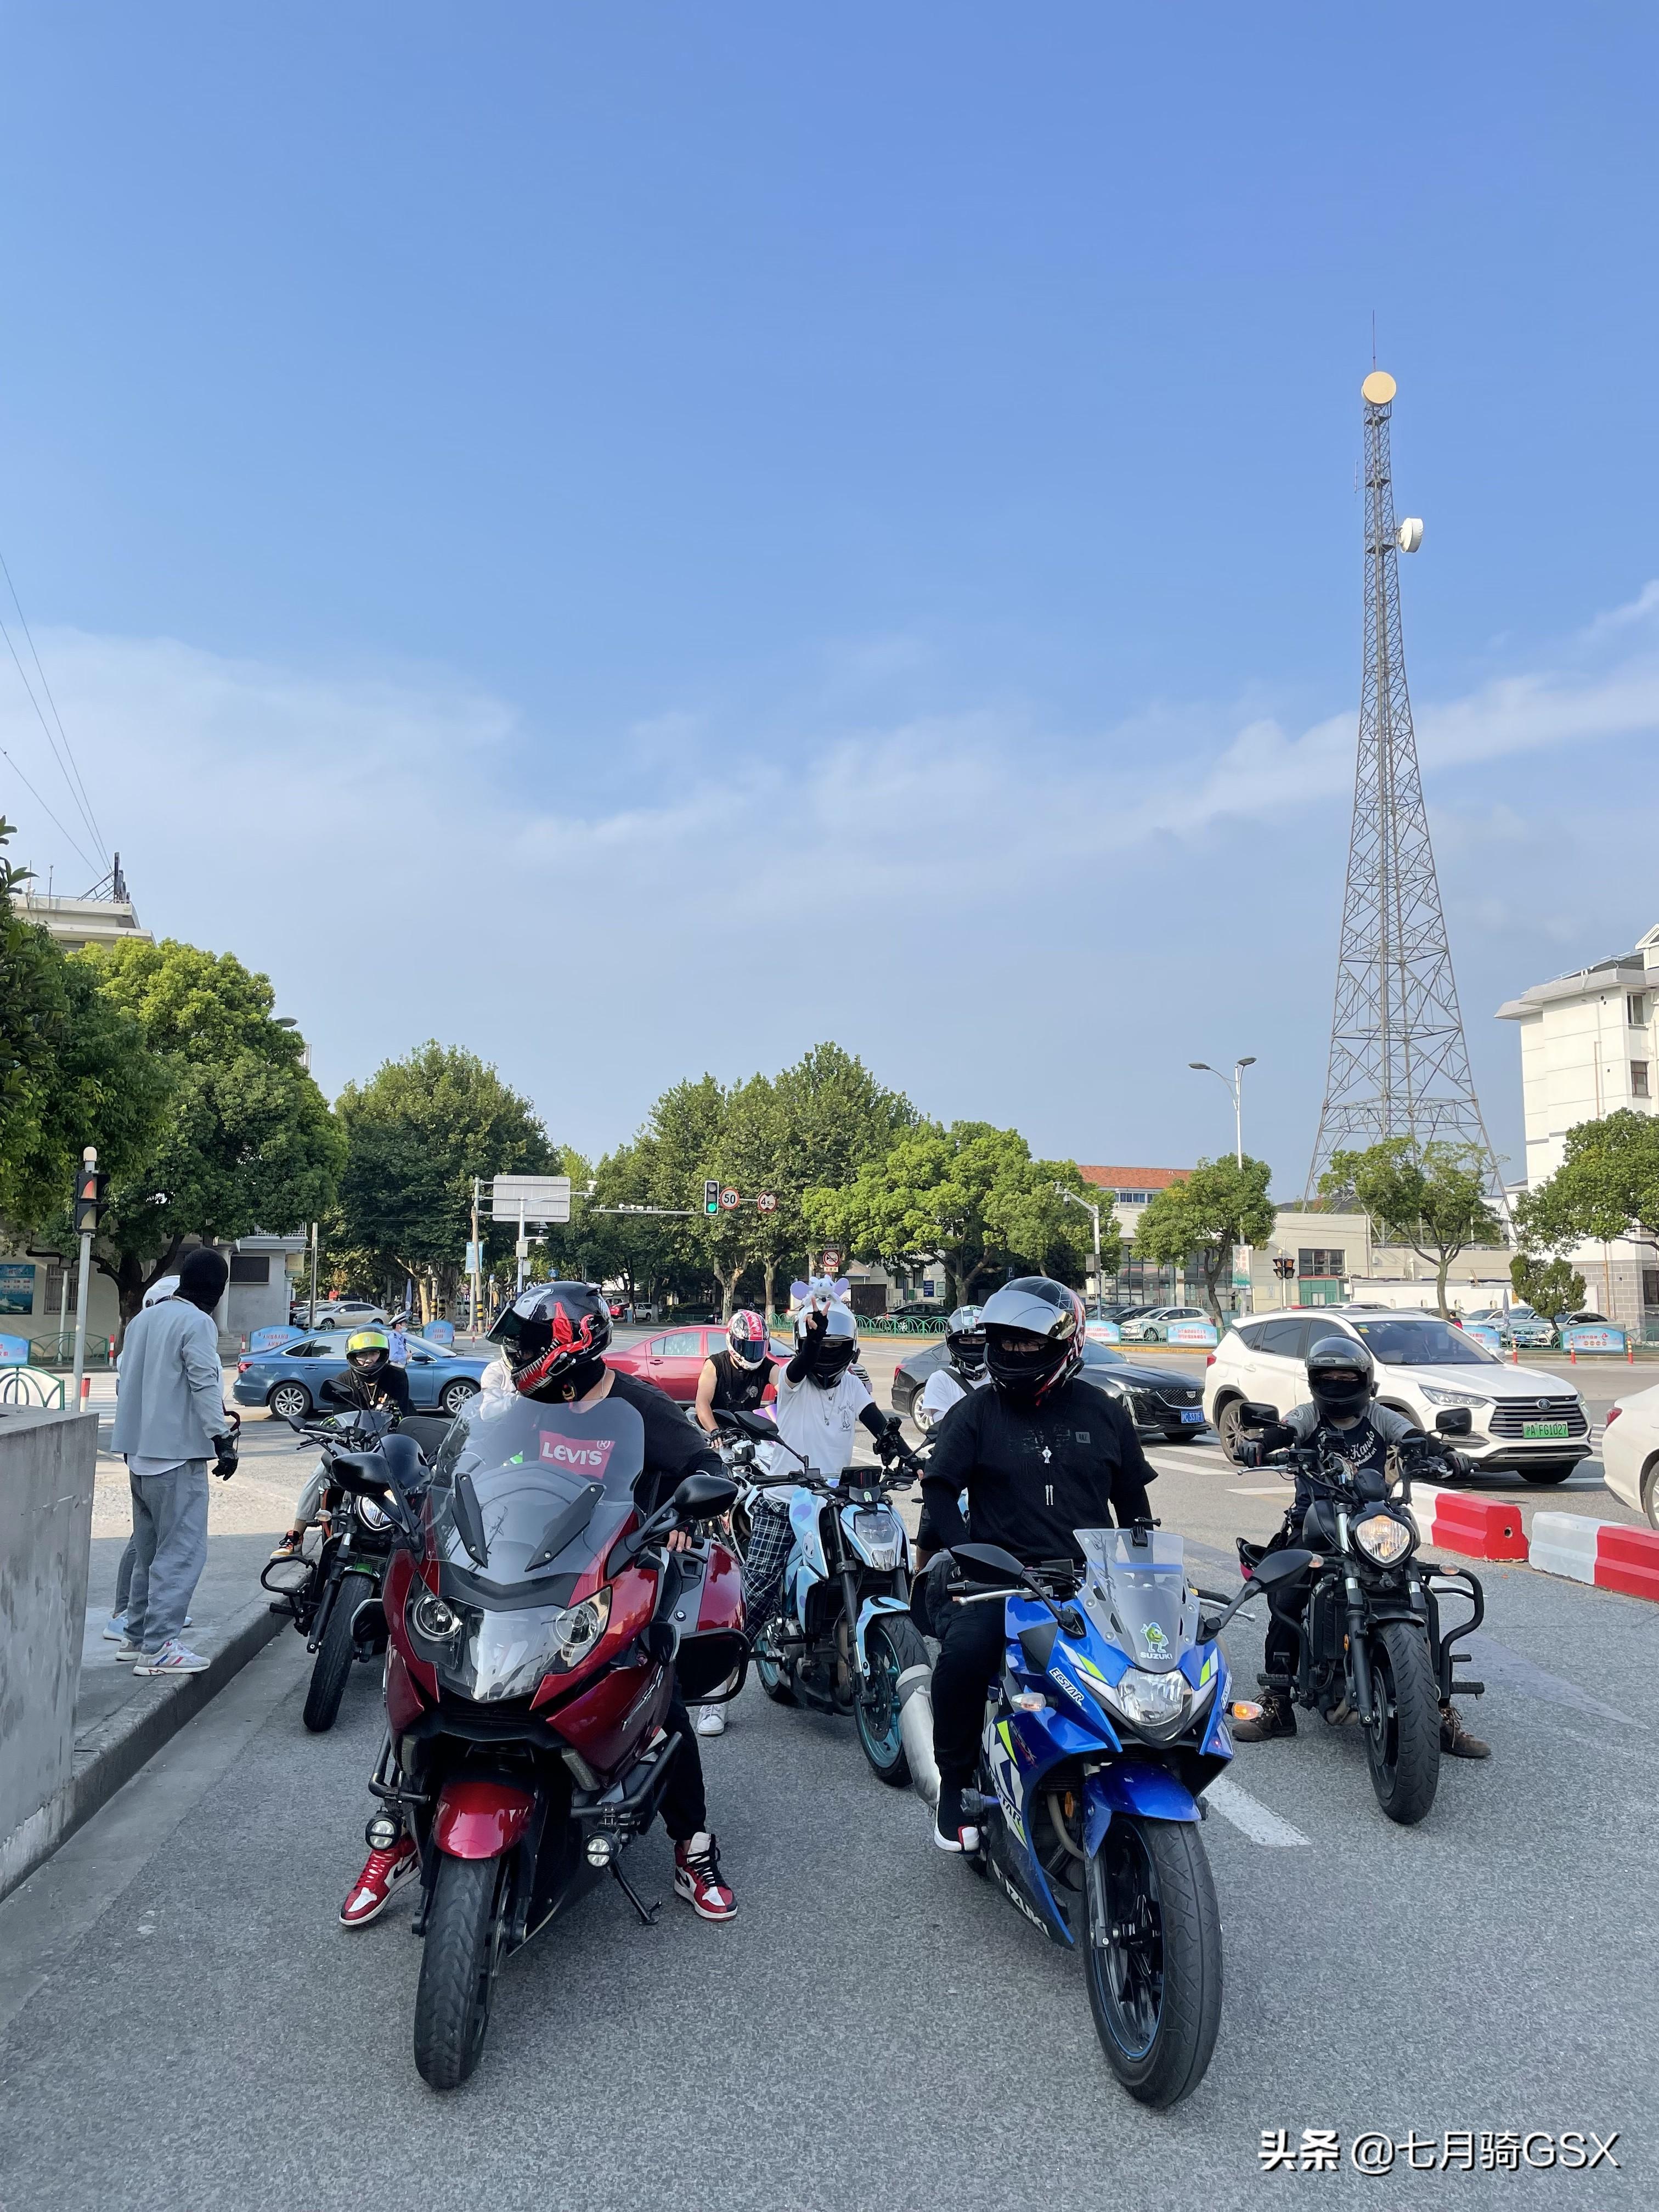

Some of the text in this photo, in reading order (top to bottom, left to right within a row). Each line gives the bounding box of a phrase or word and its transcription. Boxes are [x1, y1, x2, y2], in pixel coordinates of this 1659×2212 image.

[724, 1194, 736, 1204] 50
[1140, 1651, 1173, 1660] SUZUKI
[1049, 1667, 1085, 1707] ECSTAR
